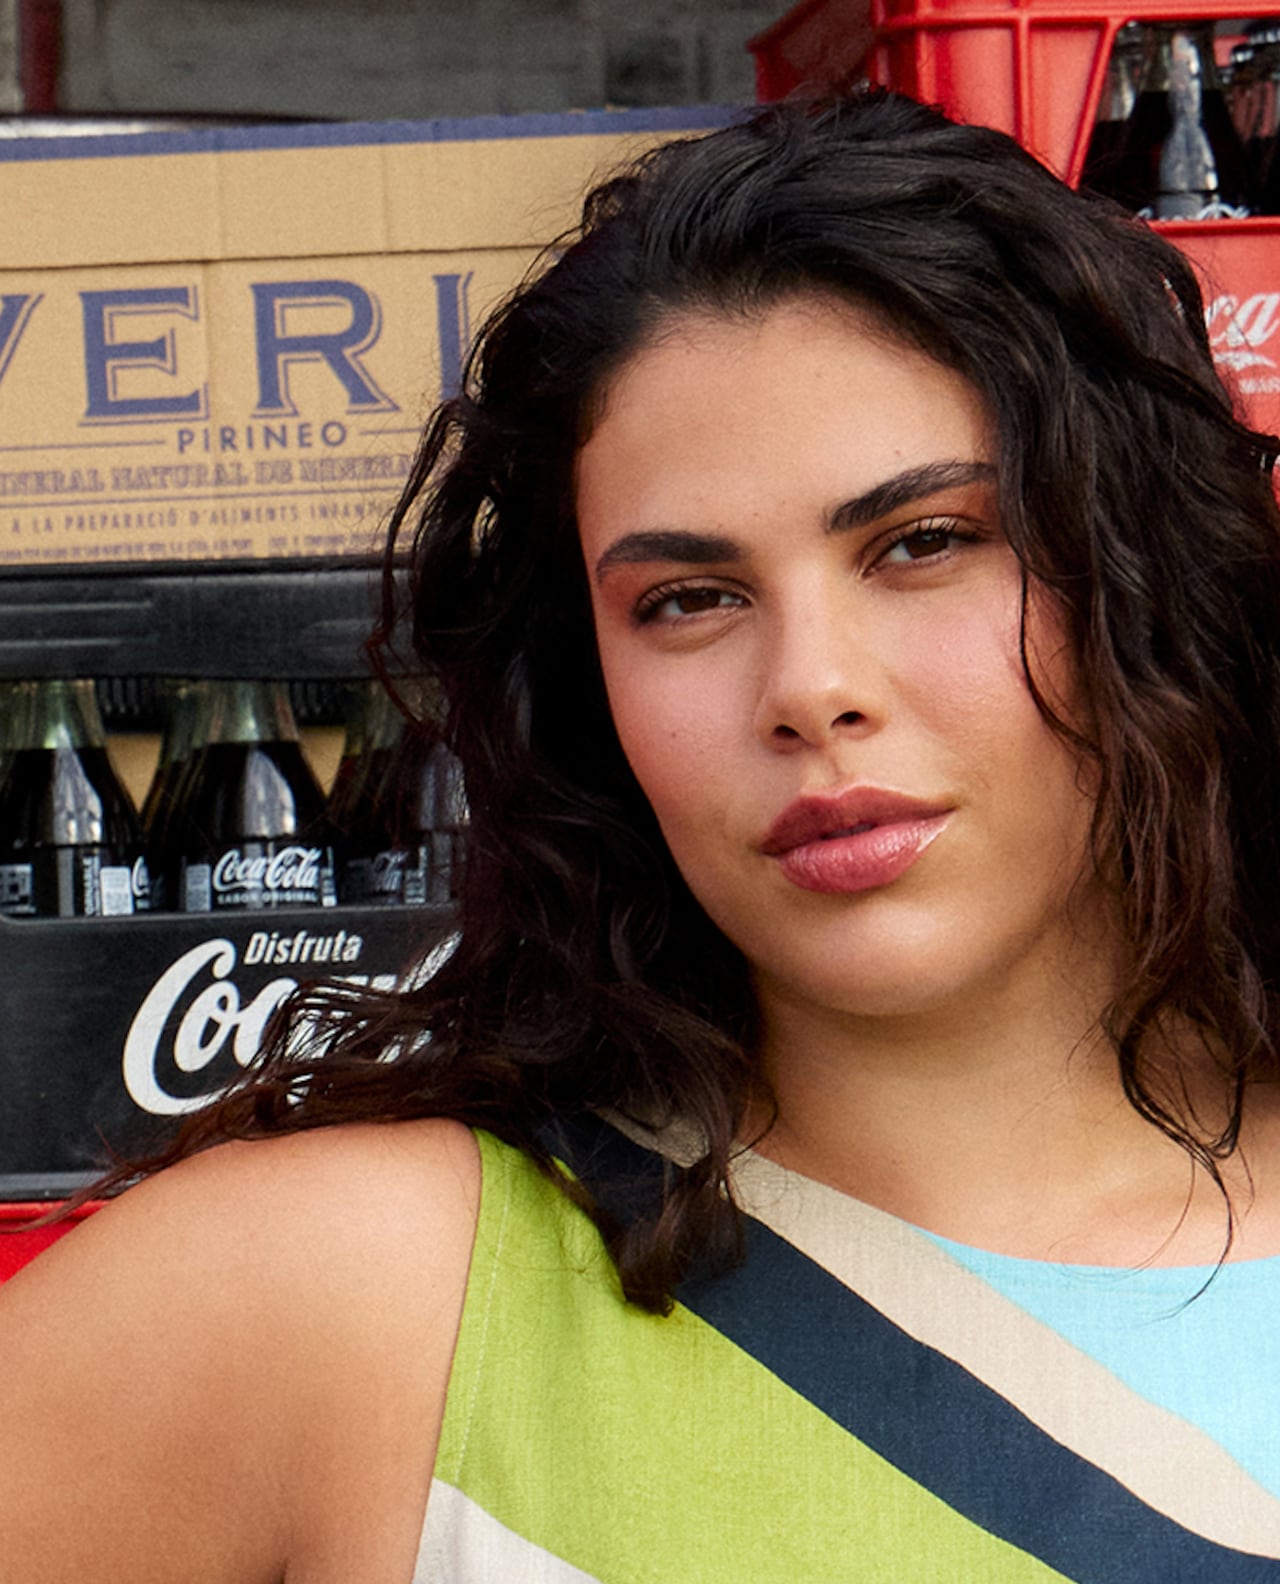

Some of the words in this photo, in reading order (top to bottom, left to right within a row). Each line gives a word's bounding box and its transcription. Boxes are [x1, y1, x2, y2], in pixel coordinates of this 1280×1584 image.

[177, 420, 348, 454] PIRINEO
[112, 461, 249, 491] NATURAL
[212, 846, 322, 892] Coca-Cola
[244, 930, 364, 966] Disfruta
